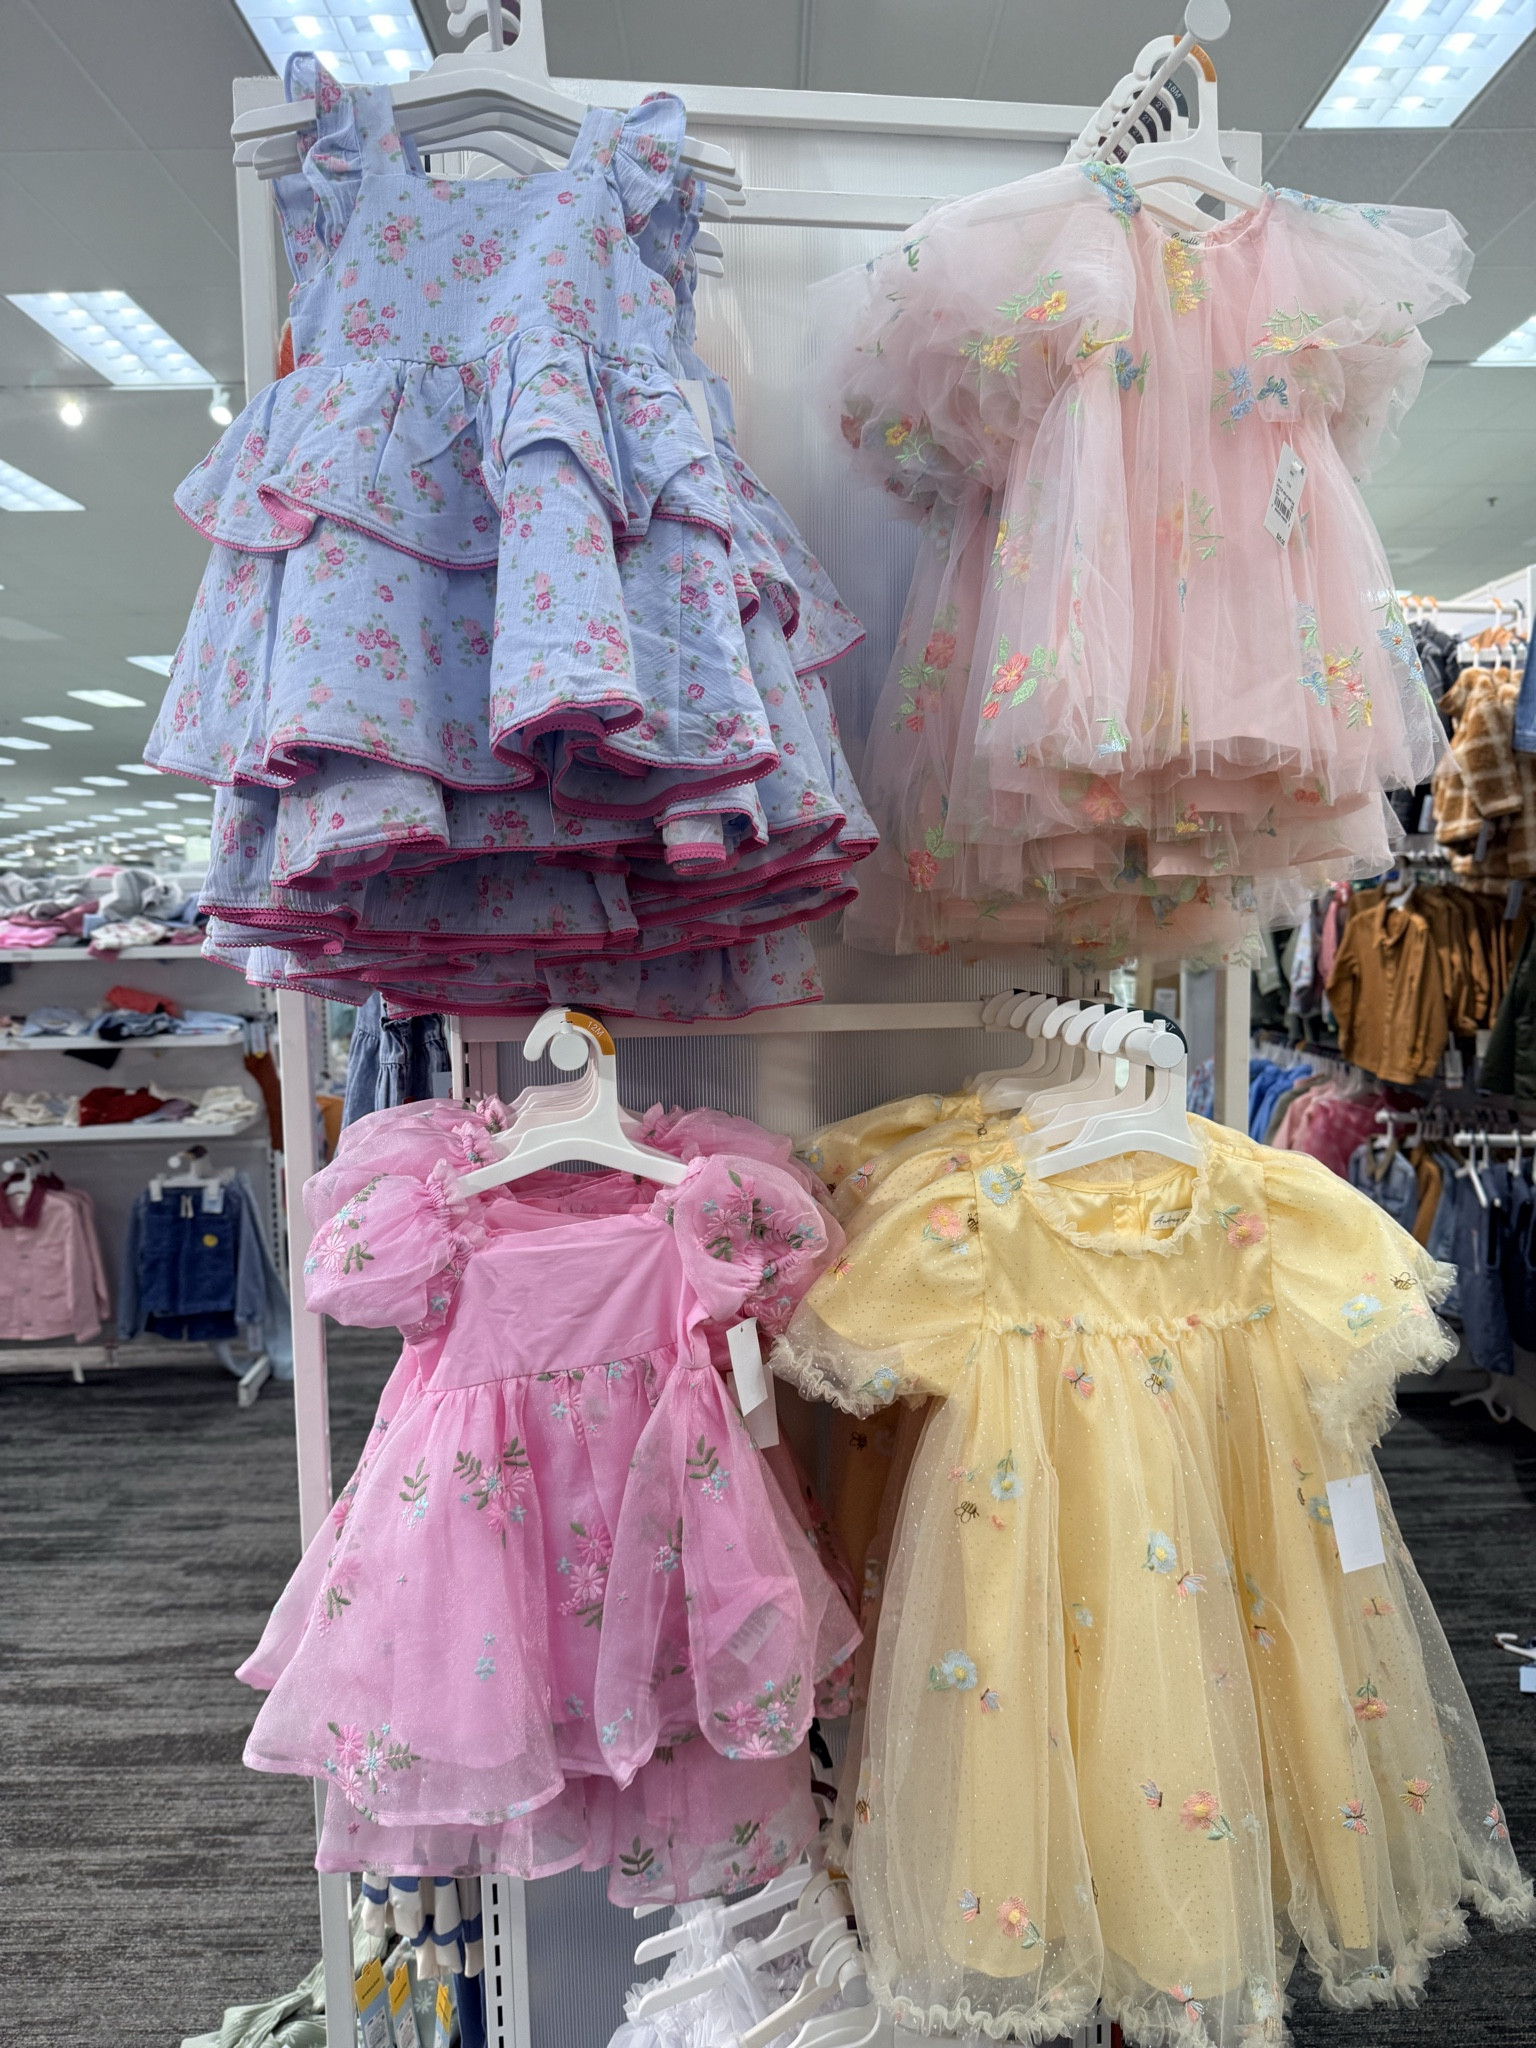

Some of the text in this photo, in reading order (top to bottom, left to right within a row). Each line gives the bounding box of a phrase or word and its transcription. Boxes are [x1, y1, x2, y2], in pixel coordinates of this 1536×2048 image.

[1167, 82, 1182, 98] 18M
[1155, 101, 1165, 112] 2T
[1142, 114, 1152, 124] 2T
[1132, 129, 1142, 138] 2T
[1117, 149, 1127, 160] 3T
[1171, 232, 1200, 245] Cmille
[588, 1021, 604, 1037] 12M
[1165, 1022, 1176, 1031] 4T
